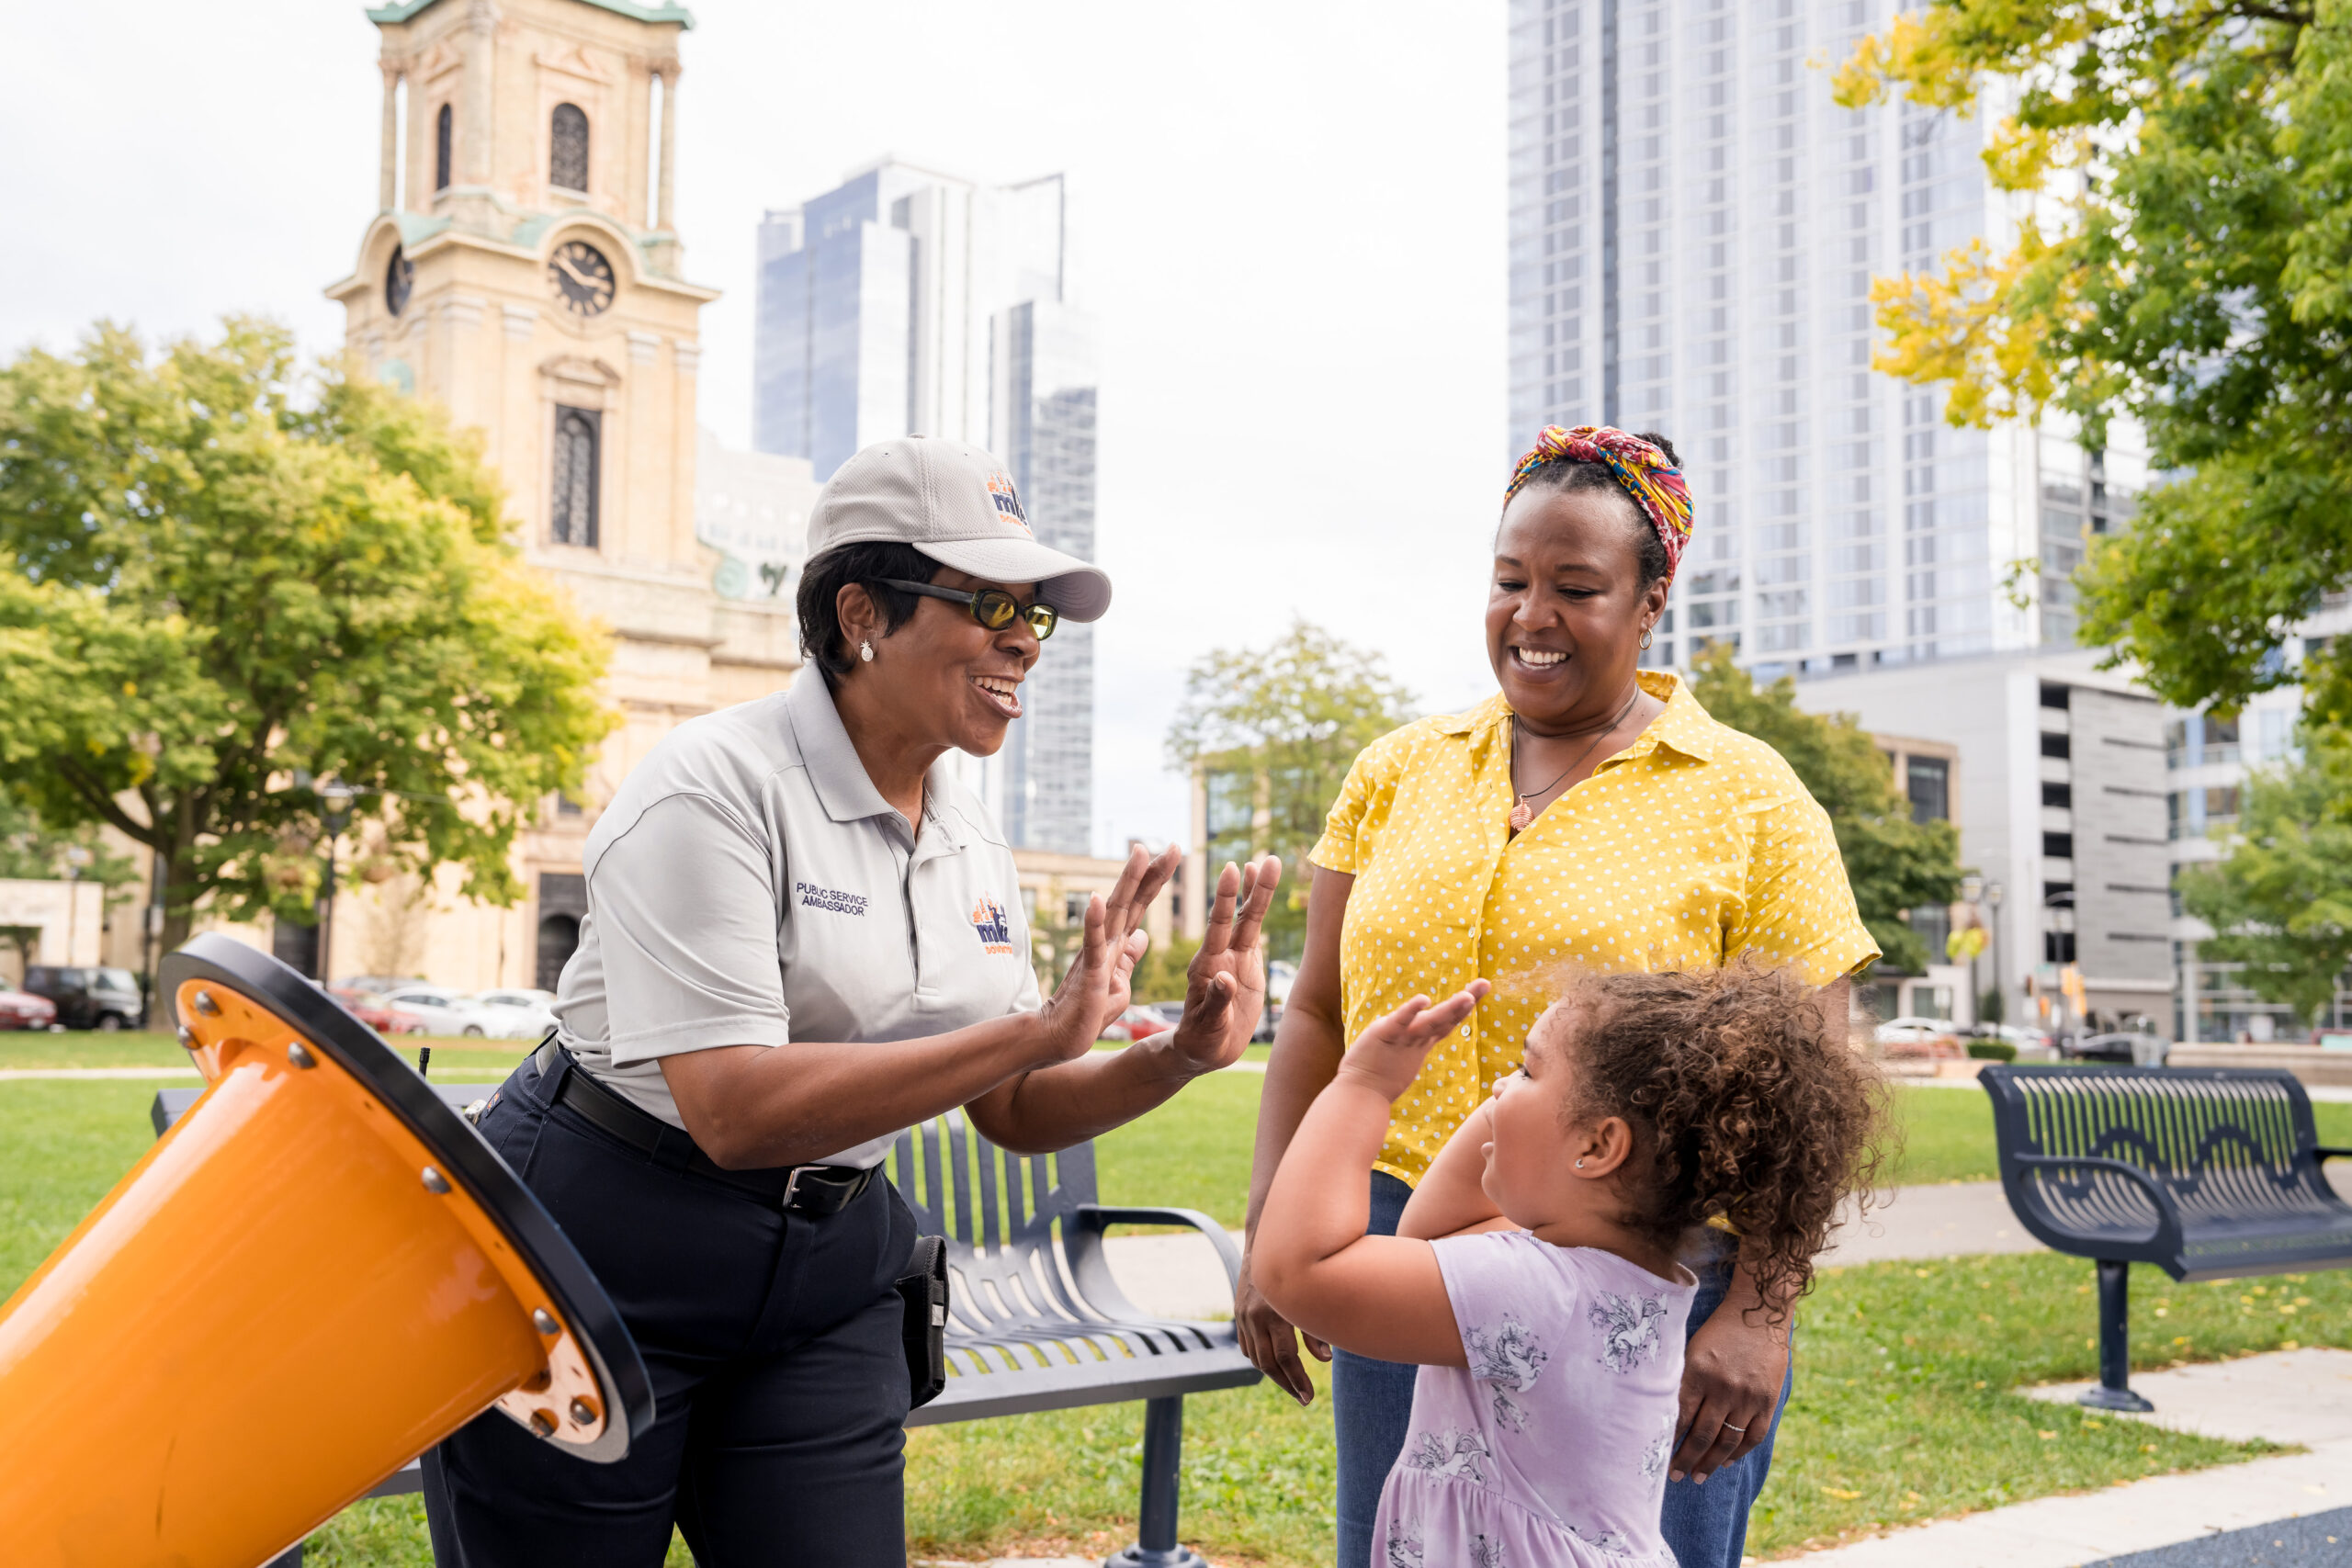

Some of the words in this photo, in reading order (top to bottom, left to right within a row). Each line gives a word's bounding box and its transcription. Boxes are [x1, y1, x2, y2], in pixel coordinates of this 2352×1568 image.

[797, 883, 828, 899] PUBLIC
[830, 890, 868, 907] SERVICE
[802, 895, 865, 917] AMBASSADOR
